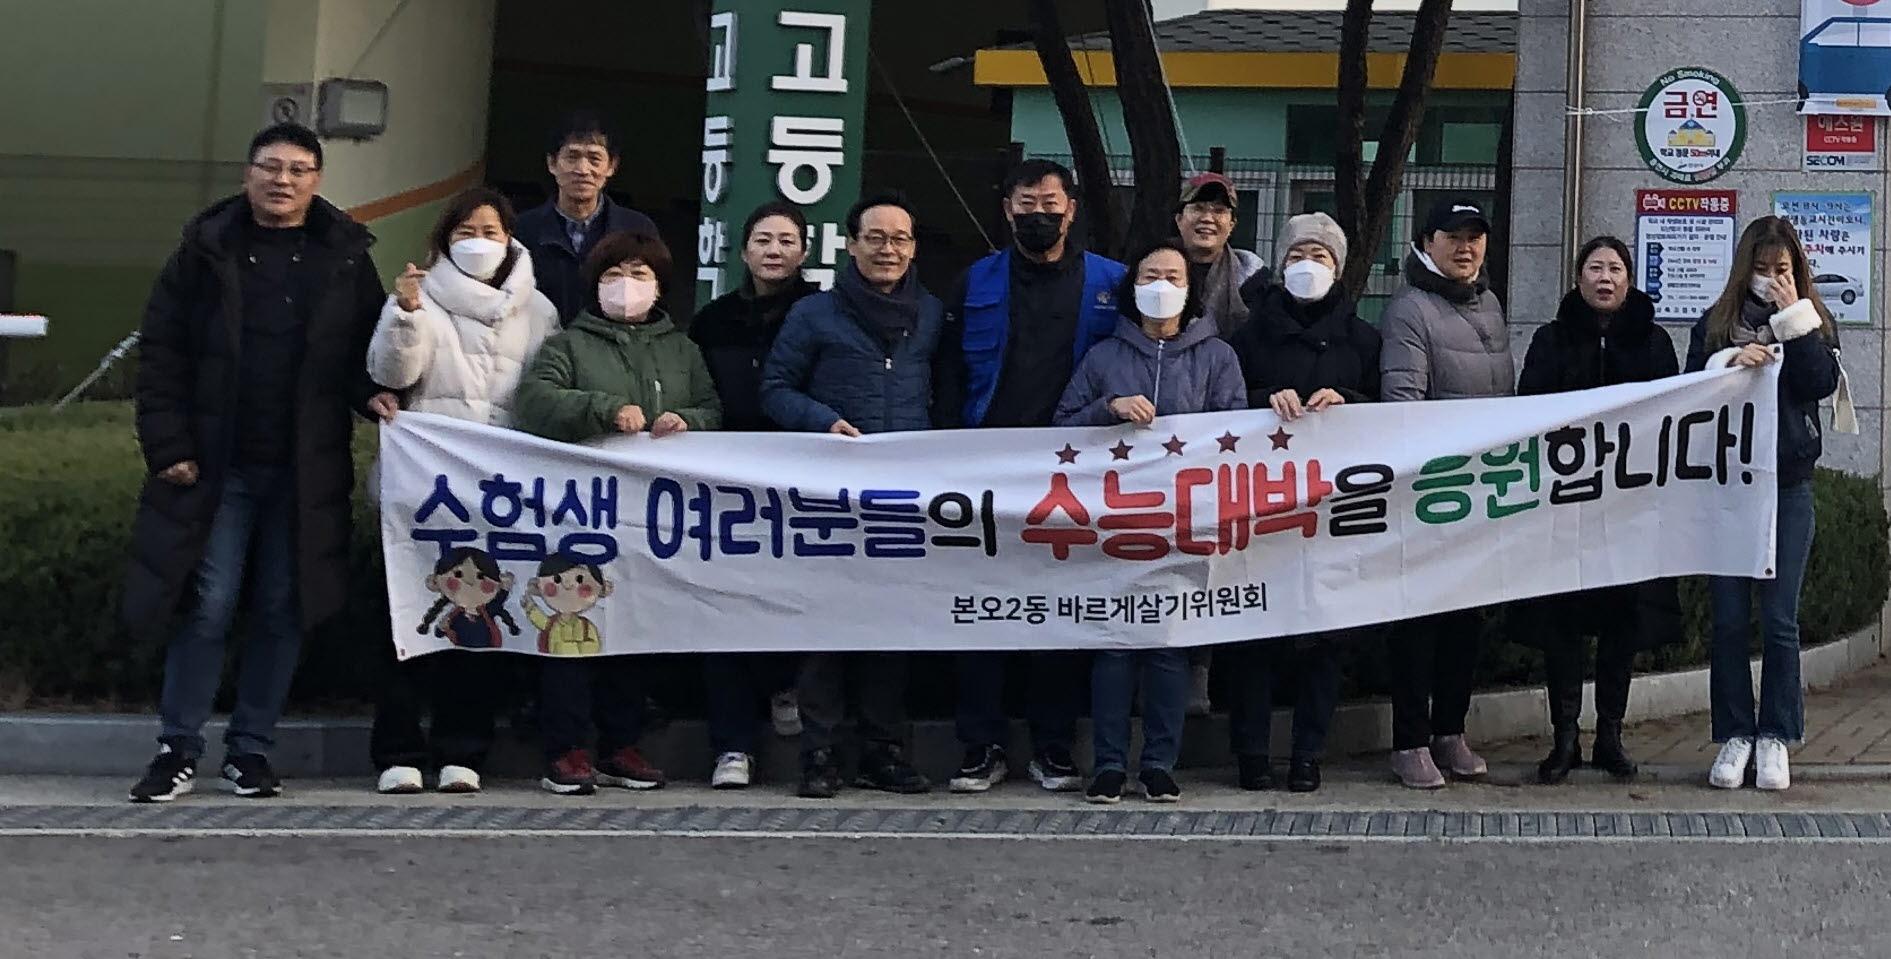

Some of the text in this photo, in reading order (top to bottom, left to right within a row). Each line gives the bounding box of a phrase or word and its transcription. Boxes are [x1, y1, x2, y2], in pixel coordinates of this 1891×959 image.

[1660, 69, 1721, 87] No Smoking
[1663, 90, 1718, 119] 금연
[1806, 155, 1845, 167] SECOM
[411, 402, 1756, 568] 수험생 여러분들의 수능대박을 응원합니다!
[949, 580, 1269, 627] 본오2동 바르게살기위원회
